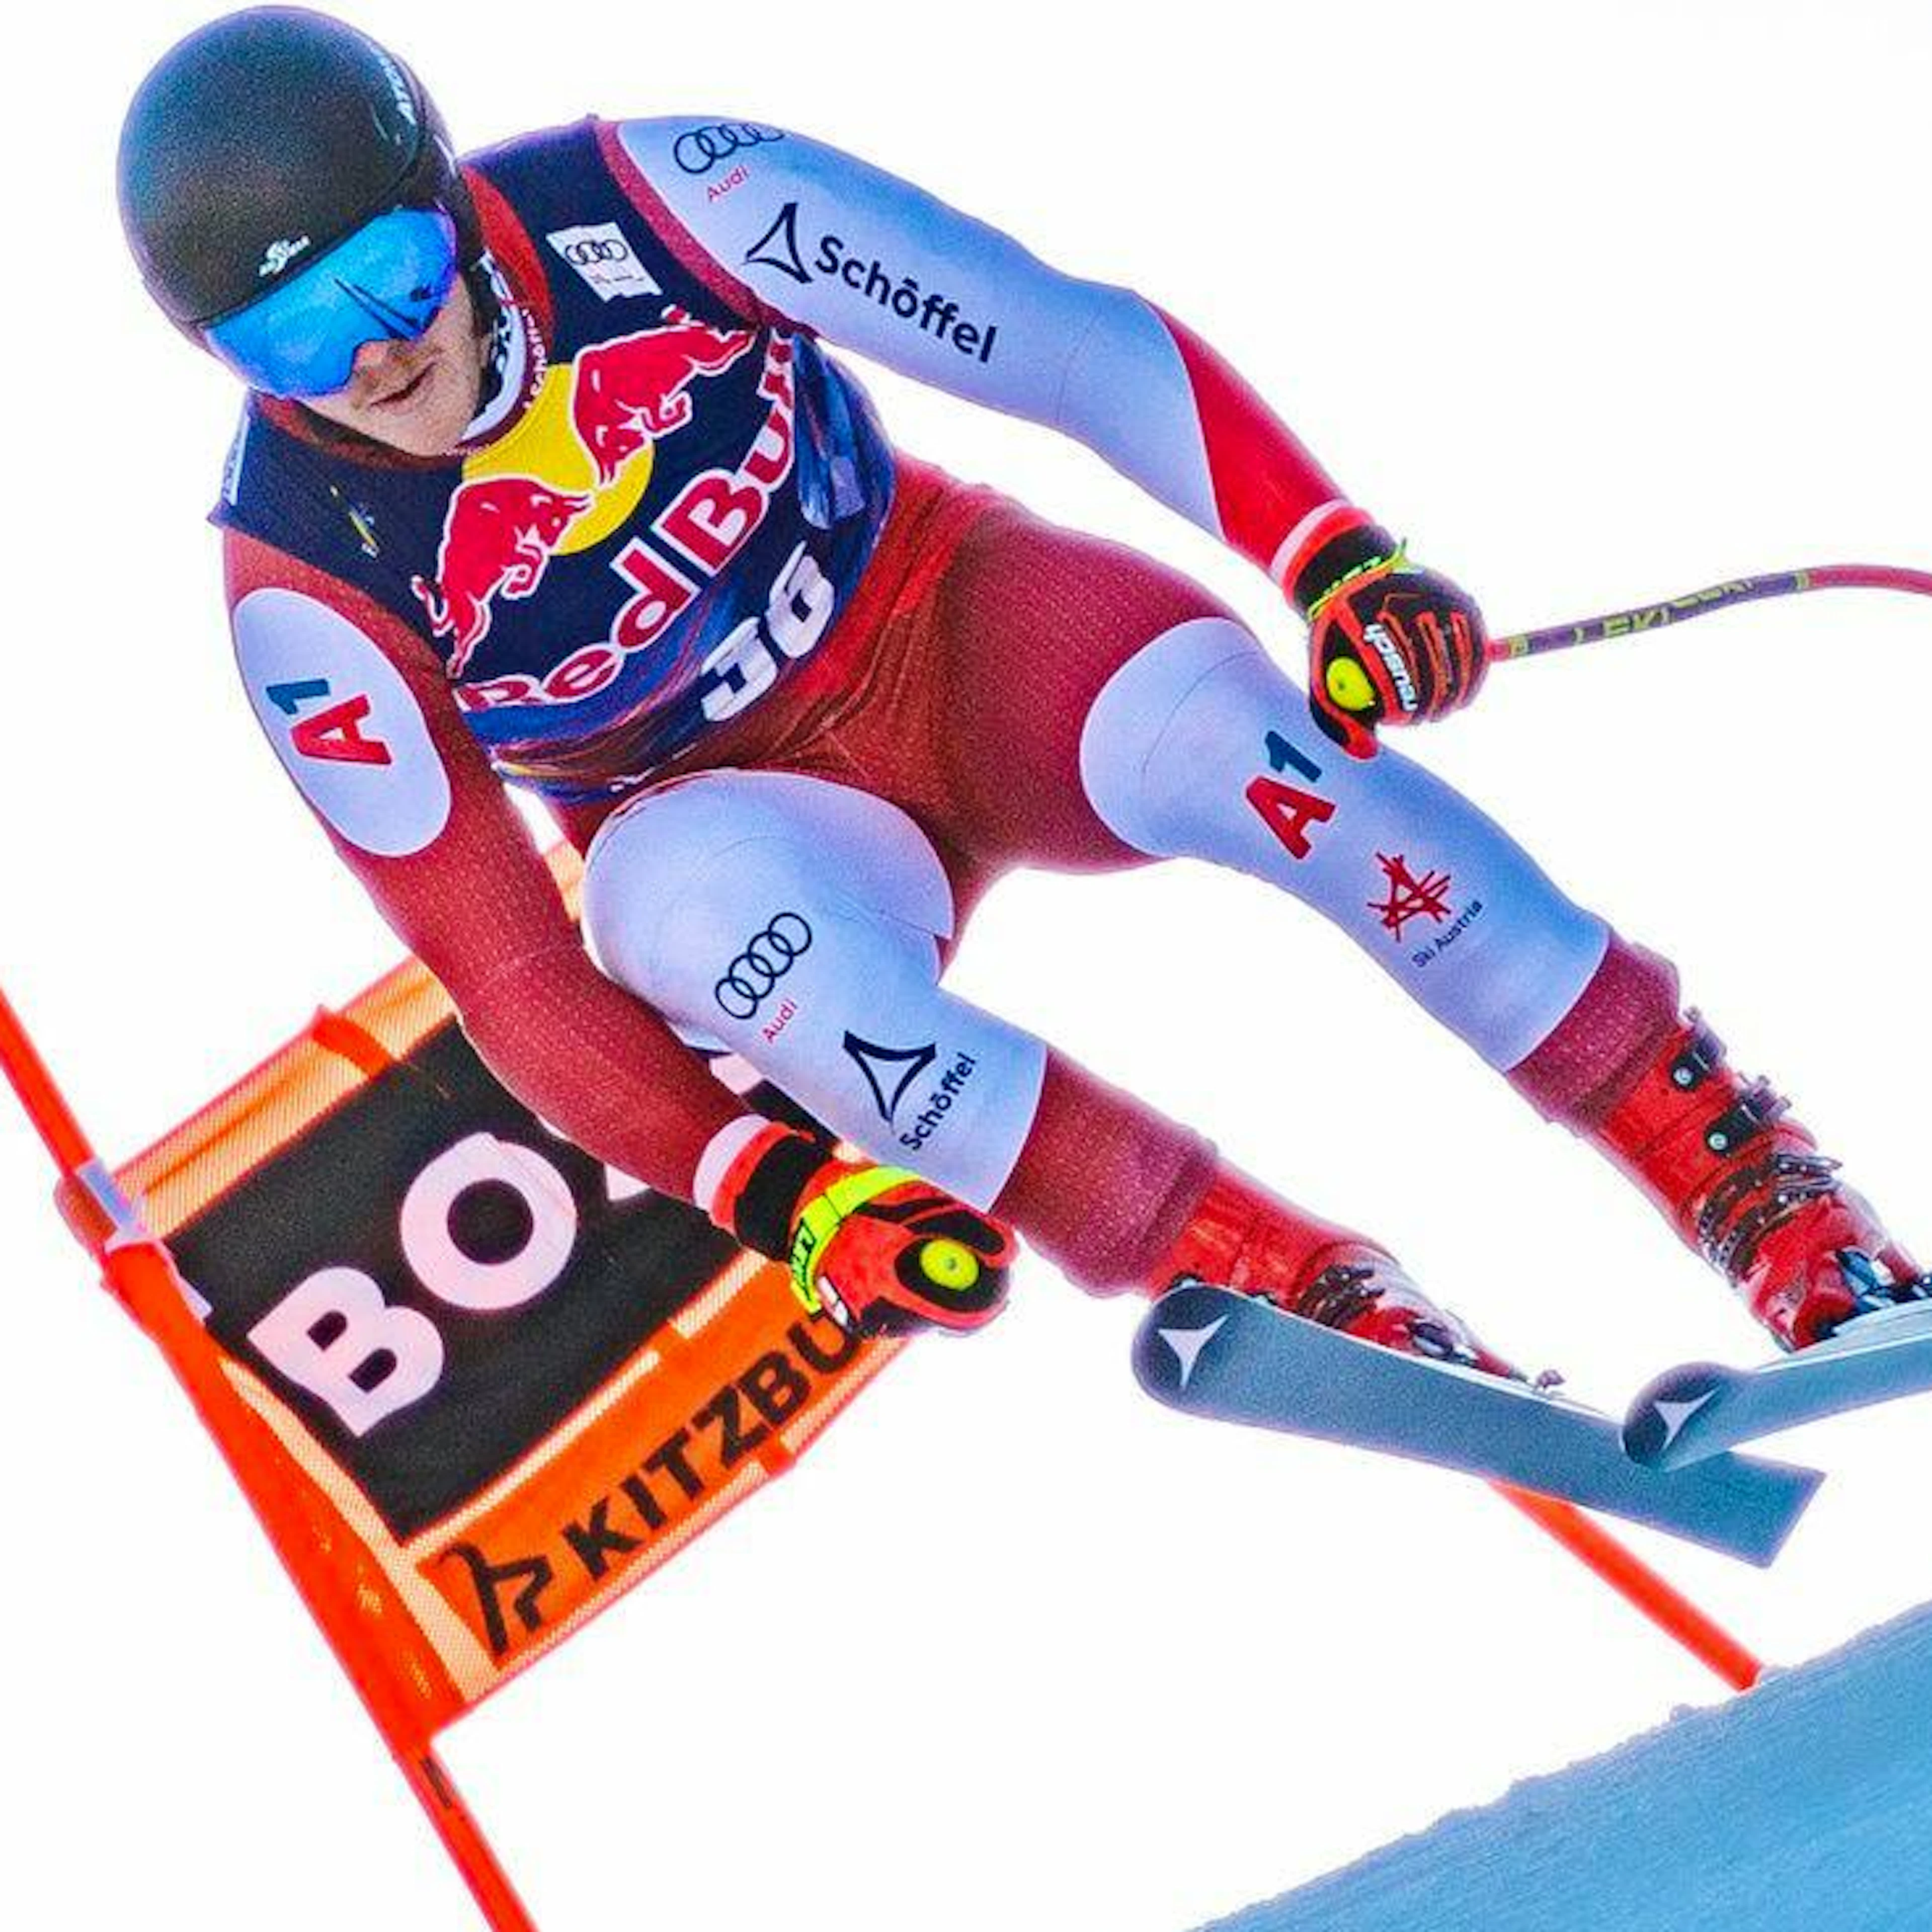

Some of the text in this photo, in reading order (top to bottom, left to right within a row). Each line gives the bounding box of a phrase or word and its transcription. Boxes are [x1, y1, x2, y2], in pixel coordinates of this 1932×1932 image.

[706, 164, 750, 202] Audi
[815, 235, 998, 363] Schöffel
[454, 536, 702, 712] Red
[1363, 622, 1418, 711] reusch
[265, 678, 393, 766] A1
[1245, 730, 1337, 859] A1
[1411, 899, 1483, 968] Ski Austria
[761, 1000, 798, 1044] Audi
[899, 1053, 977, 1151] Schöffel
[247, 1132, 653, 1438] BO
